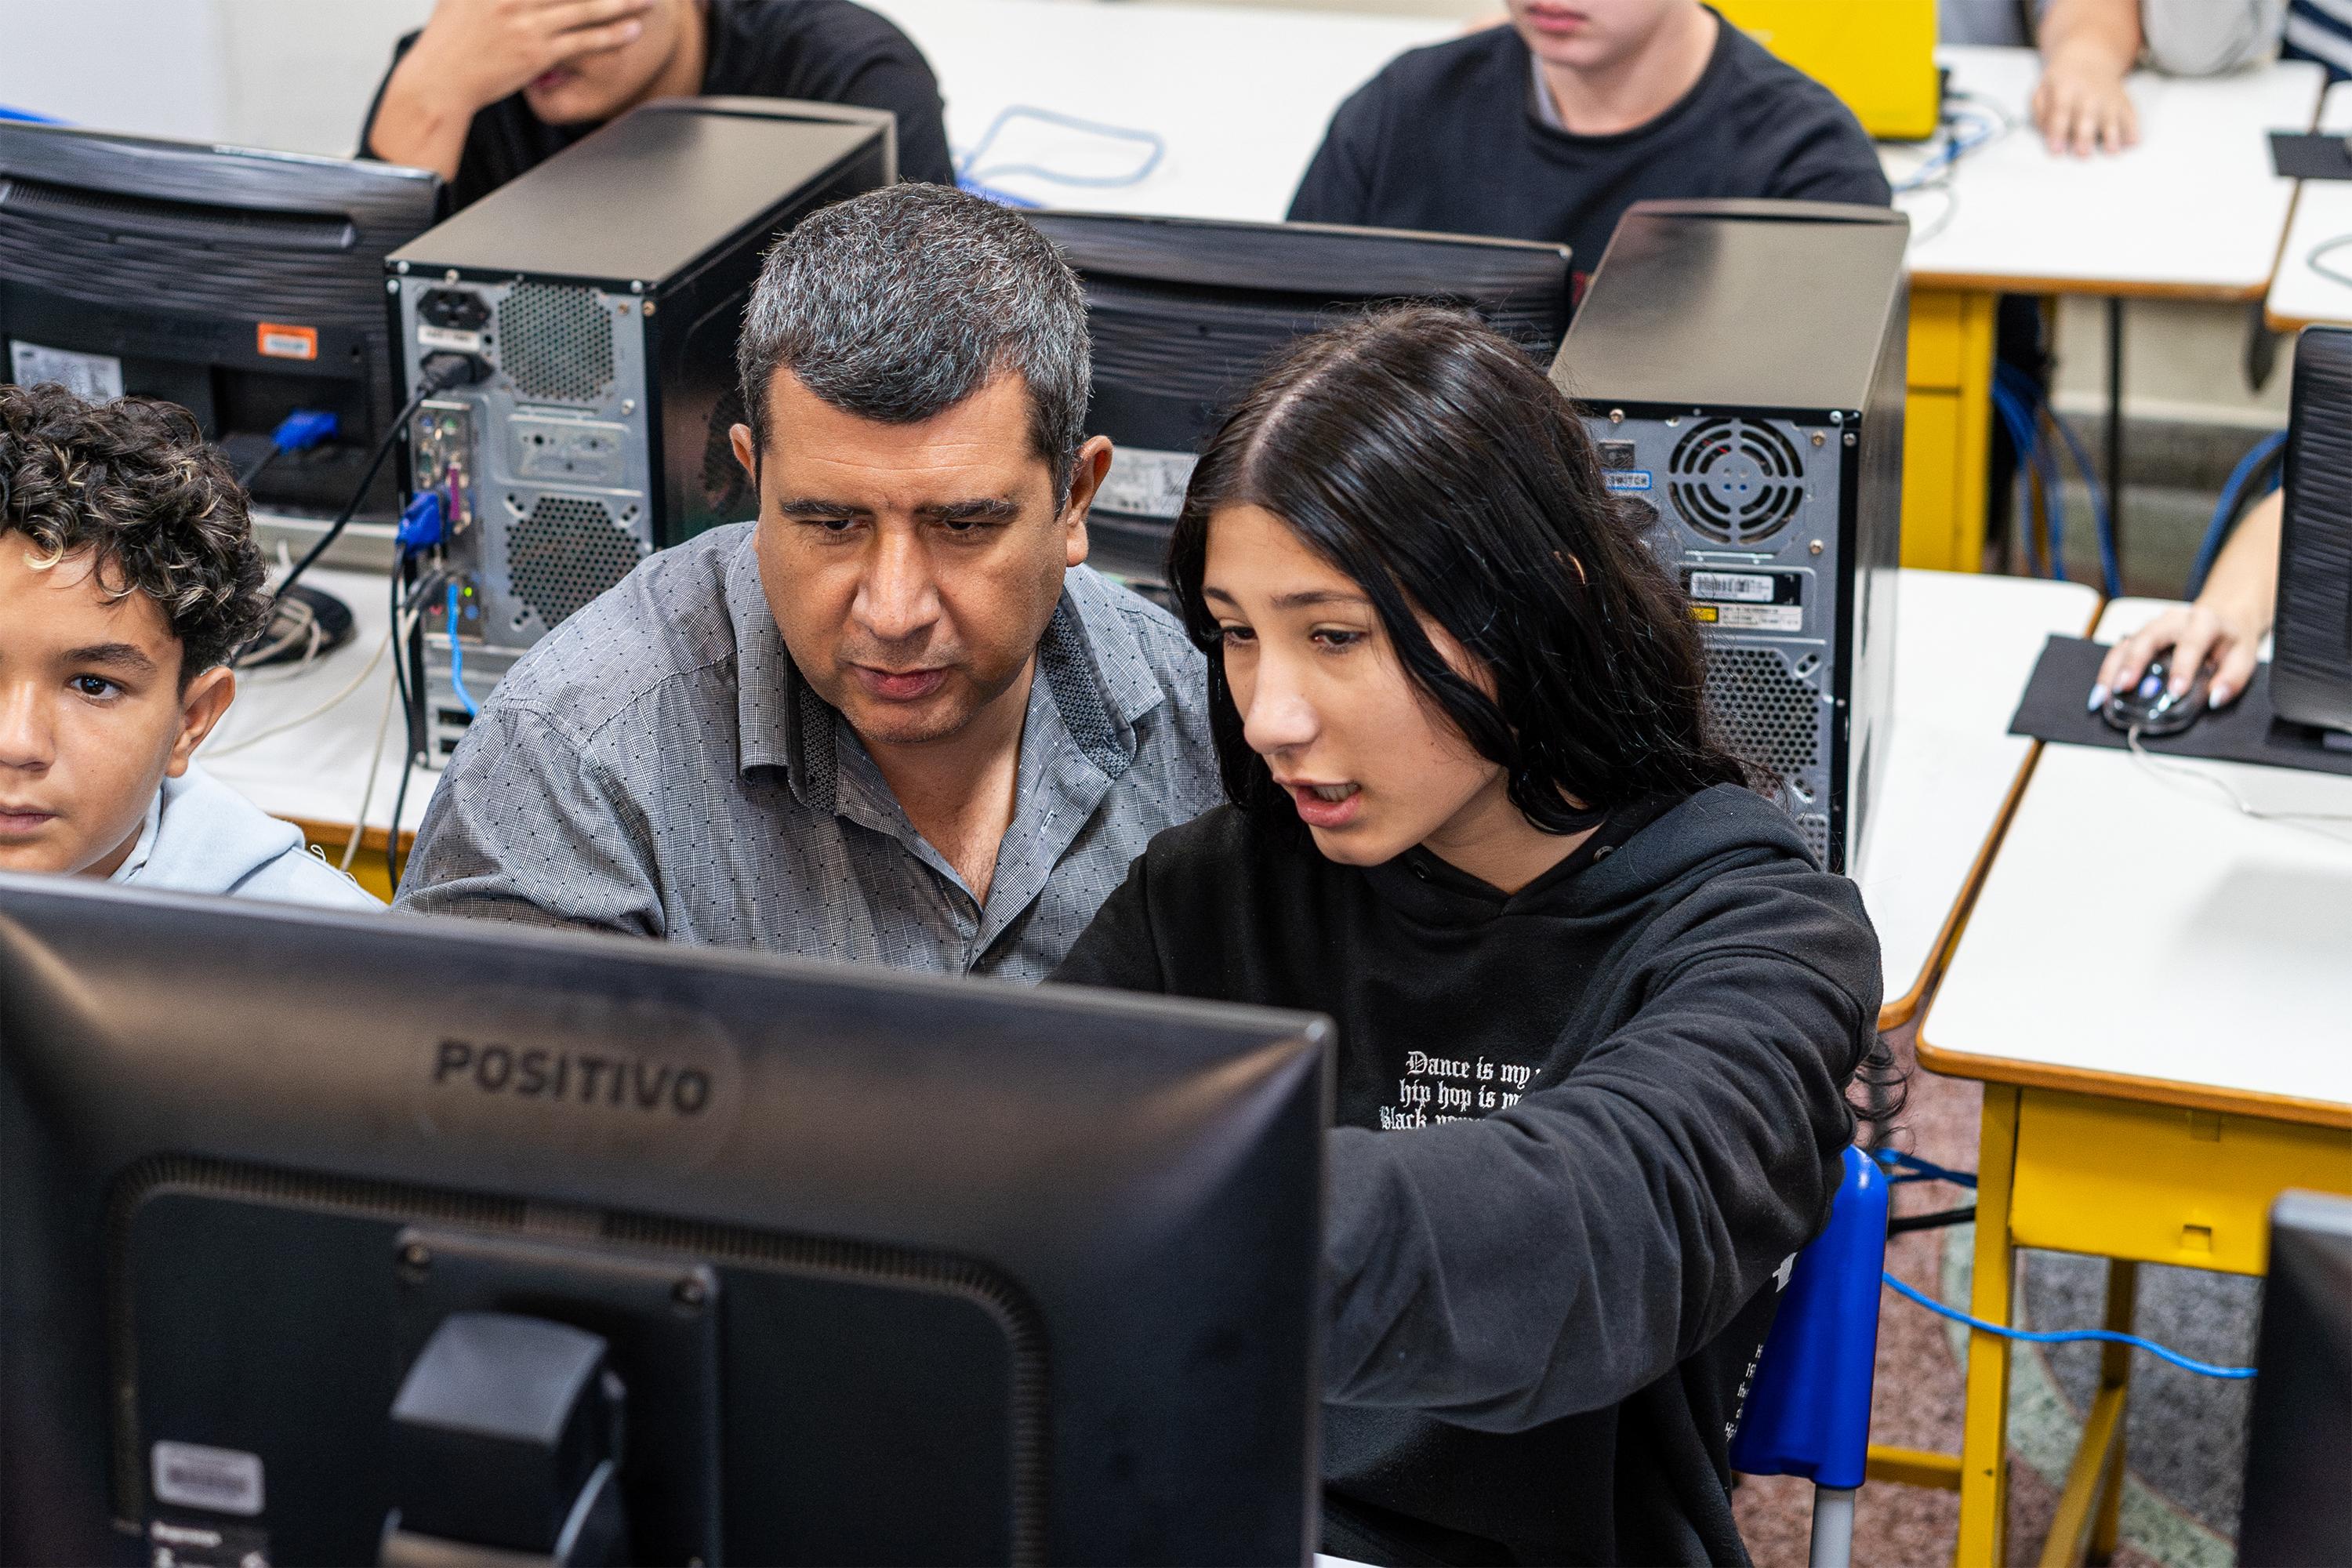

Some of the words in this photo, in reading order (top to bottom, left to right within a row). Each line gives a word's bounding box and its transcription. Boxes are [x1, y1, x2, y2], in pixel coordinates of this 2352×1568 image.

[434, 1040, 712, 1116] POSITIVO
[1406, 1051, 1470, 1079] Dance
[1475, 1056, 1494, 1080] is
[1501, 1063, 1530, 1090] my
[1399, 1078, 1431, 1108] hip
[1437, 1079, 1472, 1112] hop
[1478, 1084, 1497, 1109] is
[1501, 1092, 1523, 1110] m
[1379, 1105, 1427, 1131] Black
